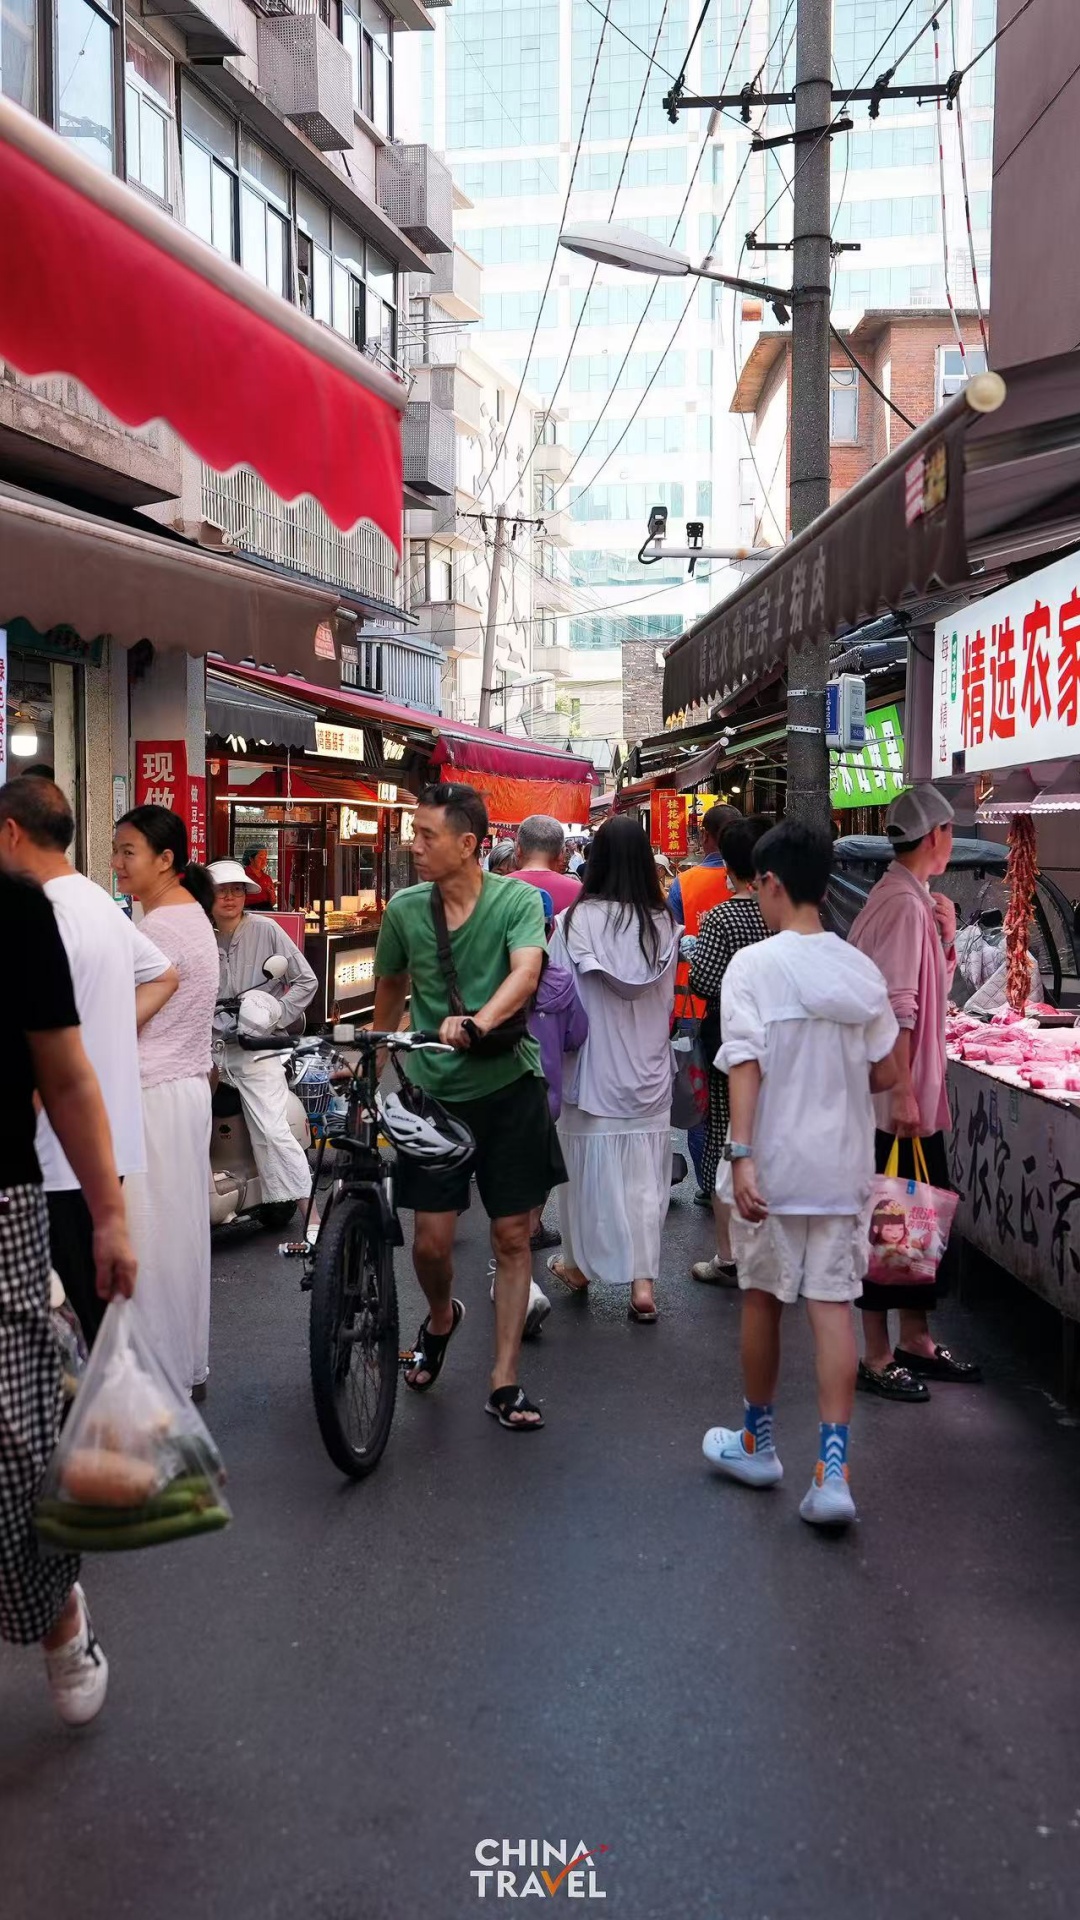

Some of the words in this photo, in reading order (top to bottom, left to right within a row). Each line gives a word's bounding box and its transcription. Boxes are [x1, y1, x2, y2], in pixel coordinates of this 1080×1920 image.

[960, 586, 1080, 749] 精选农家
[142, 752, 176, 811] 现做
[667, 799, 681, 851] 桂花糯米藕
